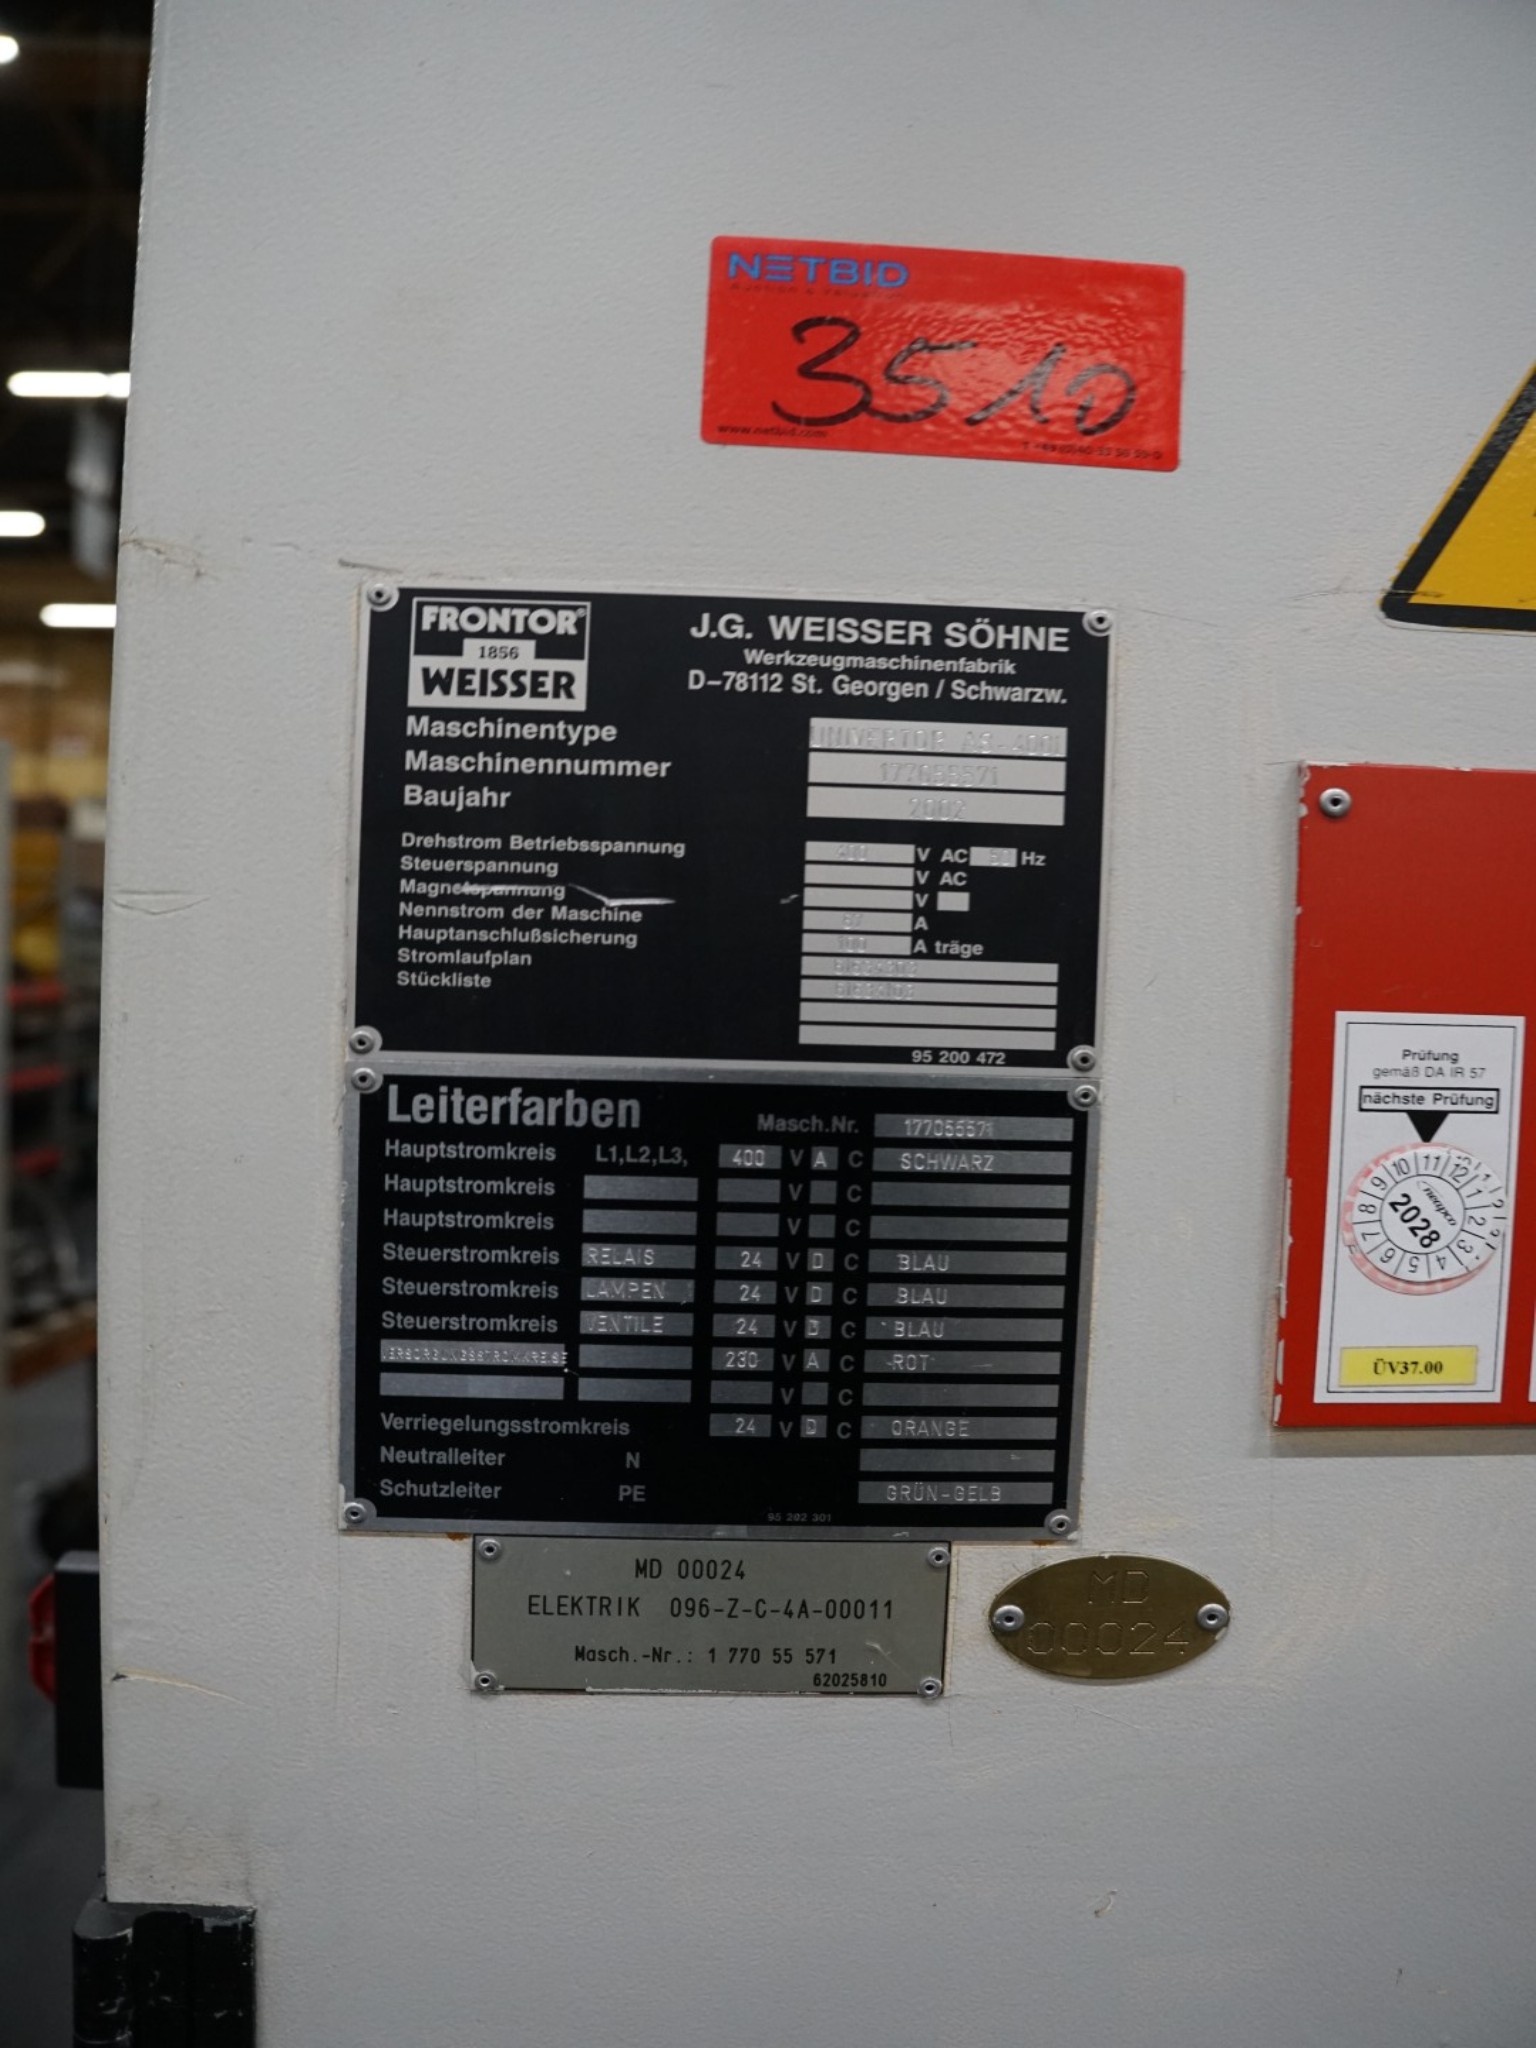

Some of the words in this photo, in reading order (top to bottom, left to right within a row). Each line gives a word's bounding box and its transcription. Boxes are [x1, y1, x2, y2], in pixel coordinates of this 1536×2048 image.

[728, 253, 908, 288] NETBID
[771, 316, 1137, 436] 3510
[689, 612, 753, 640] J.G.
[769, 614, 932, 646] WEISSER
[944, 616, 1071, 652] SÖHNE
[478, 645, 519, 660] 1856
[744, 647, 1017, 675] Werkzeugmaschinenfabrik
[421, 666, 576, 700] WEISSER
[791, 671, 823, 695] St.
[832, 674, 929, 702] Georgen
[935, 679, 945, 699] /
[950, 679, 1068, 704] Schwarzw.
[406, 715, 618, 747] Maschinentype
[404, 750, 671, 777] Maschinennummer
[879, 761, 999, 788] 17705571
[403, 784, 511, 812] Baujahr
[908, 796, 967, 821] 2002
[401, 832, 502, 850] Drehstrom
[509, 834, 686, 859] Betriebsspannung
[916, 847, 931, 862] V
[940, 848, 968, 864] AC
[1021, 851, 1047, 867] Hz
[400, 855, 559, 878] Steuerspannung
[916, 870, 930, 885] V
[939, 871, 968, 886] AC
[915, 893, 929, 908] V
[399, 902, 504, 919] Nennstrom
[511, 903, 544, 920] der
[550, 904, 643, 923] Maschine
[914, 915, 929, 931] A
[398, 924, 638, 949] Hauptanschlußsicherung
[913, 937, 928, 954] A
[934, 940, 984, 959] träge
[397, 948, 532, 968] Stromlaufplan
[397, 970, 492, 988] Stückliste
[912, 1049, 932, 1063] 95
[939, 1051, 970, 1065] 200
[976, 1051, 1006, 1065] 472
[1402, 1049, 1460, 1065] Prüfung
[1372, 1066, 1420, 1080] gemäß
[1424, 1066, 1445, 1078] DA
[1450, 1066, 1465, 1078] IR
[1469, 1067, 1487, 1079] 57
[387, 1083, 641, 1128] Leiterfarben
[757, 1113, 859, 1135] Masch.Nr.
[903, 1118, 995, 1138] 17705571
[1363, 1091, 1426, 1105] nächste
[1432, 1092, 1495, 1109] Prüfung
[385, 1138, 557, 1162] Hauptstromkreis
[732, 1149, 766, 1168] 400
[790, 1149, 805, 1167] V
[813, 1150, 828, 1168] A
[849, 1150, 864, 1169] C
[900, 1152, 995, 1171] SCHWARZ
[1391, 1157, 1411, 1176] 10
[1422, 1154, 1442, 1172] 11
[1370, 1175, 1389, 1192] 9
[1449, 1162, 1470, 1184] 12
[384, 1173, 555, 1197] Hauptstromkreis
[789, 1183, 803, 1201] V
[847, 1184, 863, 1203] C
[1466, 1188, 1483, 1199] 1
[1357, 1203, 1377, 1216] 8
[1387, 1191, 1442, 1249] 2028
[1467, 1215, 1488, 1227] 2
[383, 1208, 554, 1232] Hauptstromkreis
[787, 1217, 802, 1236] V
[845, 1218, 861, 1237] C
[1361, 1230, 1381, 1242] 7
[1456, 1238, 1475, 1254] 3
[382, 1242, 560, 1265] Steuerstromkreis
[586, 1247, 656, 1266] RELAIS
[740, 1251, 762, 1269] 24
[785, 1252, 800, 1270] V
[812, 1253, 824, 1270] D
[844, 1253, 860, 1271] C
[898, 1253, 949, 1272] BLAU
[1379, 1247, 1396, 1264] 6
[1408, 1255, 1421, 1274] 5
[1436, 1255, 1447, 1271] 4
[381, 1276, 559, 1299] Steuerstromkreis
[585, 1281, 665, 1299] LAMPEN
[739, 1284, 761, 1302] 24
[784, 1285, 799, 1303] V
[811, 1285, 823, 1303] D
[842, 1286, 858, 1305] C
[896, 1287, 948, 1305] BLAU
[381, 1311, 558, 1333] Steuerstromkreis
[585, 1314, 664, 1333] VENTILE
[736, 1318, 758, 1336] 24
[783, 1320, 798, 1338] V
[807, 1319, 819, 1337] D
[841, 1320, 856, 1339] C
[893, 1320, 944, 1338] BLAU
[725, 1350, 759, 1369] 230
[782, 1353, 797, 1372] V
[806, 1352, 820, 1370] A
[839, 1354, 856, 1373] C
[1373, 1357, 1444, 1377] ÜV37.00
[780, 1386, 795, 1405] V
[838, 1388, 854, 1407] C
[381, 1412, 630, 1438] Verriegelungsstromkreis
[735, 1417, 757, 1434] 24
[779, 1421, 794, 1439] V
[805, 1418, 817, 1436] D
[836, 1421, 852, 1440] C
[891, 1419, 970, 1438] ORANGE
[380, 1445, 506, 1467] Neutralleiter
[625, 1451, 640, 1469] N
[380, 1478, 502, 1499] Schutzleiter
[618, 1484, 646, 1502] PE
[886, 1481, 1002, 1503] GRÜN-GELB
[634, 1558, 662, 1580] MD
[677, 1558, 746, 1581] 00024
[1088, 1569, 1151, 1605] MD
[528, 1594, 641, 1618] ELEKTRIK
[669, 1597, 894, 1620] 096-Z-C-4A-00011
[1026, 1620, 1190, 1656] 00024
[708, 1647, 717, 1664] 1
[728, 1647, 761, 1664] 770
[772, 1647, 794, 1664] 55
[805, 1647, 837, 1665] 571
[812, 1671, 888, 1688] 62025810
